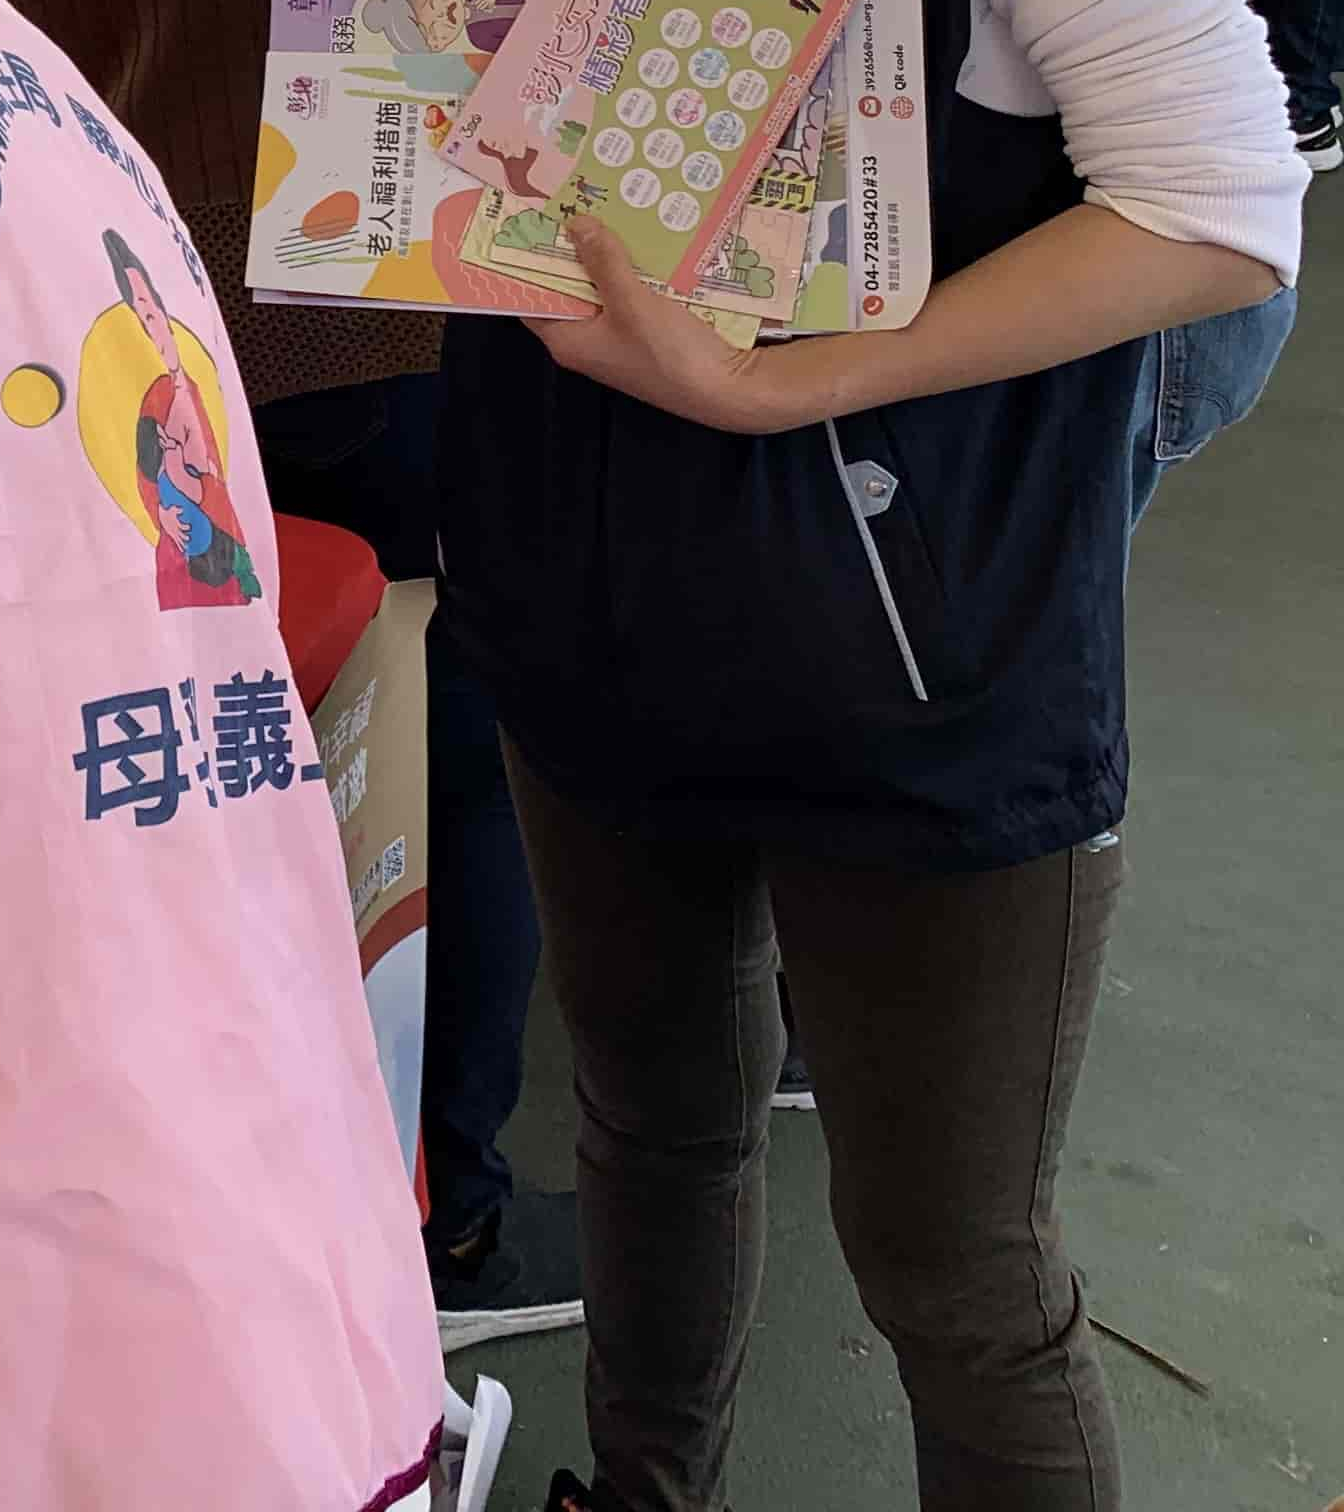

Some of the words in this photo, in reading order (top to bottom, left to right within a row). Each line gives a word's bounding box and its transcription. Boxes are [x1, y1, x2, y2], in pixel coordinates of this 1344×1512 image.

[894, 43, 905, 69] code
[894, 71, 906, 91] QR
[367, 102, 402, 258] 老人福利措施
[862, 153, 879, 292] 04-7285420#33
[72, 668, 326, 828] 母義
